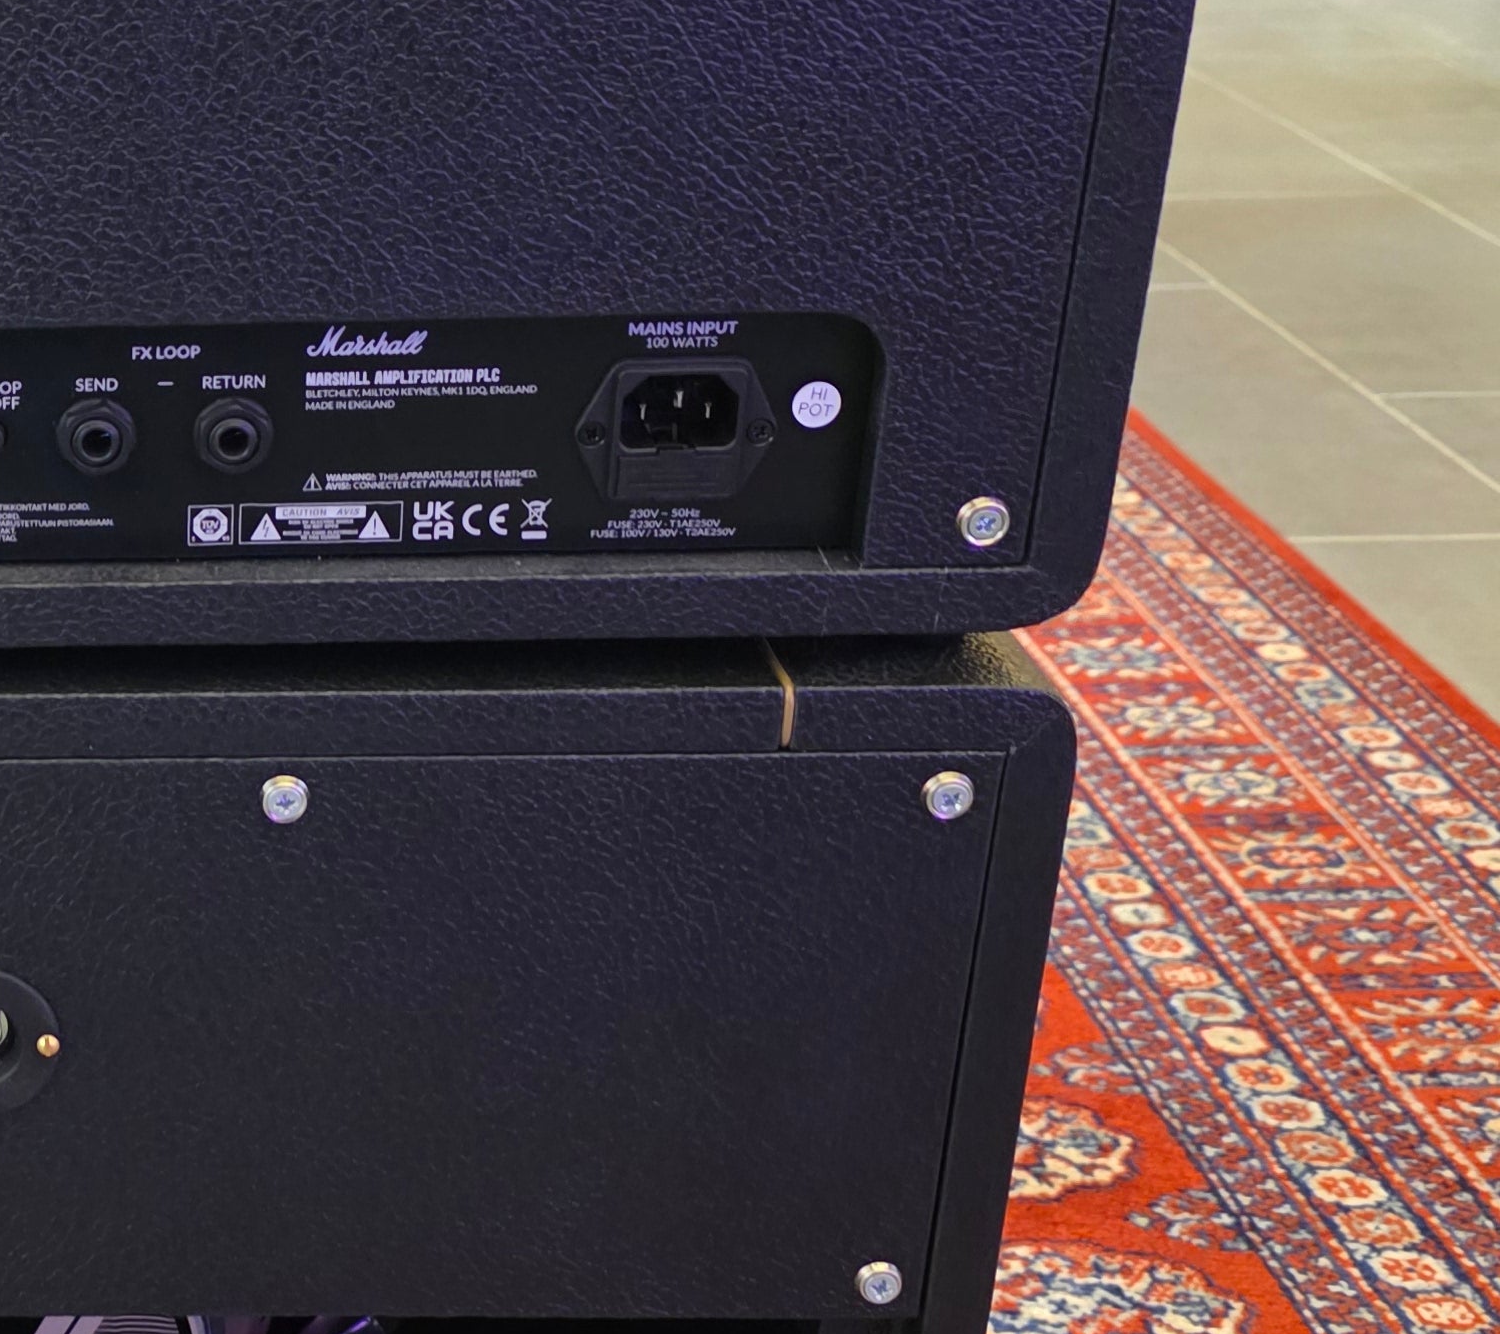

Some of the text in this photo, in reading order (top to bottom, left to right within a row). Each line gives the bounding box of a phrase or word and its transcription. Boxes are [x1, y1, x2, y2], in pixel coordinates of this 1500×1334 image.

[628, 320, 739, 337] MAINS INPUT
[306, 325, 429, 357] Marshall
[646, 336, 719, 349] 100 WATTS
[131, 345, 201, 360] FX LOOP
[75, 378, 118, 392] SEND
[202, 375, 266, 390] RETURN
[305, 367, 500, 387] MARSHALL AMPLIFICATION PLC
[305, 389, 361, 399] BLETCHLEY,
[362, 387, 399, 398] MILTON
[400, 386, 440, 397] KEYNES,
[441, 386, 463, 396] MK1
[489, 384, 538, 395] ENGLAND
[811, 387, 828, 401] HI
[305, 399, 396, 411] MADE IN ENGLAND
[798, 402, 833, 417] POT
[379, 472, 398, 480] THIS
[400, 471, 452, 480] APPARATUS
[454, 471, 479, 479] MUST
[481, 470, 492, 479] BE
[494, 469, 537, 478] EARTHED.
[353, 480, 409, 489] CONNECTER
[410, 480, 430, 488] CET
[430, 479, 472, 488] APPAREIL
[481, 479, 492, 487] LA
[494, 478, 523, 487] TERRE.
[283, 507, 360, 517] CAUTION AVIS
[413, 501, 455, 521] UK
[629, 509, 659, 519] 230V
[671, 508, 701, 518] 50Hz
[462, 503, 510, 536] CE
[607, 520, 635, 529] FUSE:
[637, 519, 662, 528] 230V
[412, 520, 454, 541] CA
[590, 529, 618, 539] FUSE:
[621, 529, 646, 538] 100V
